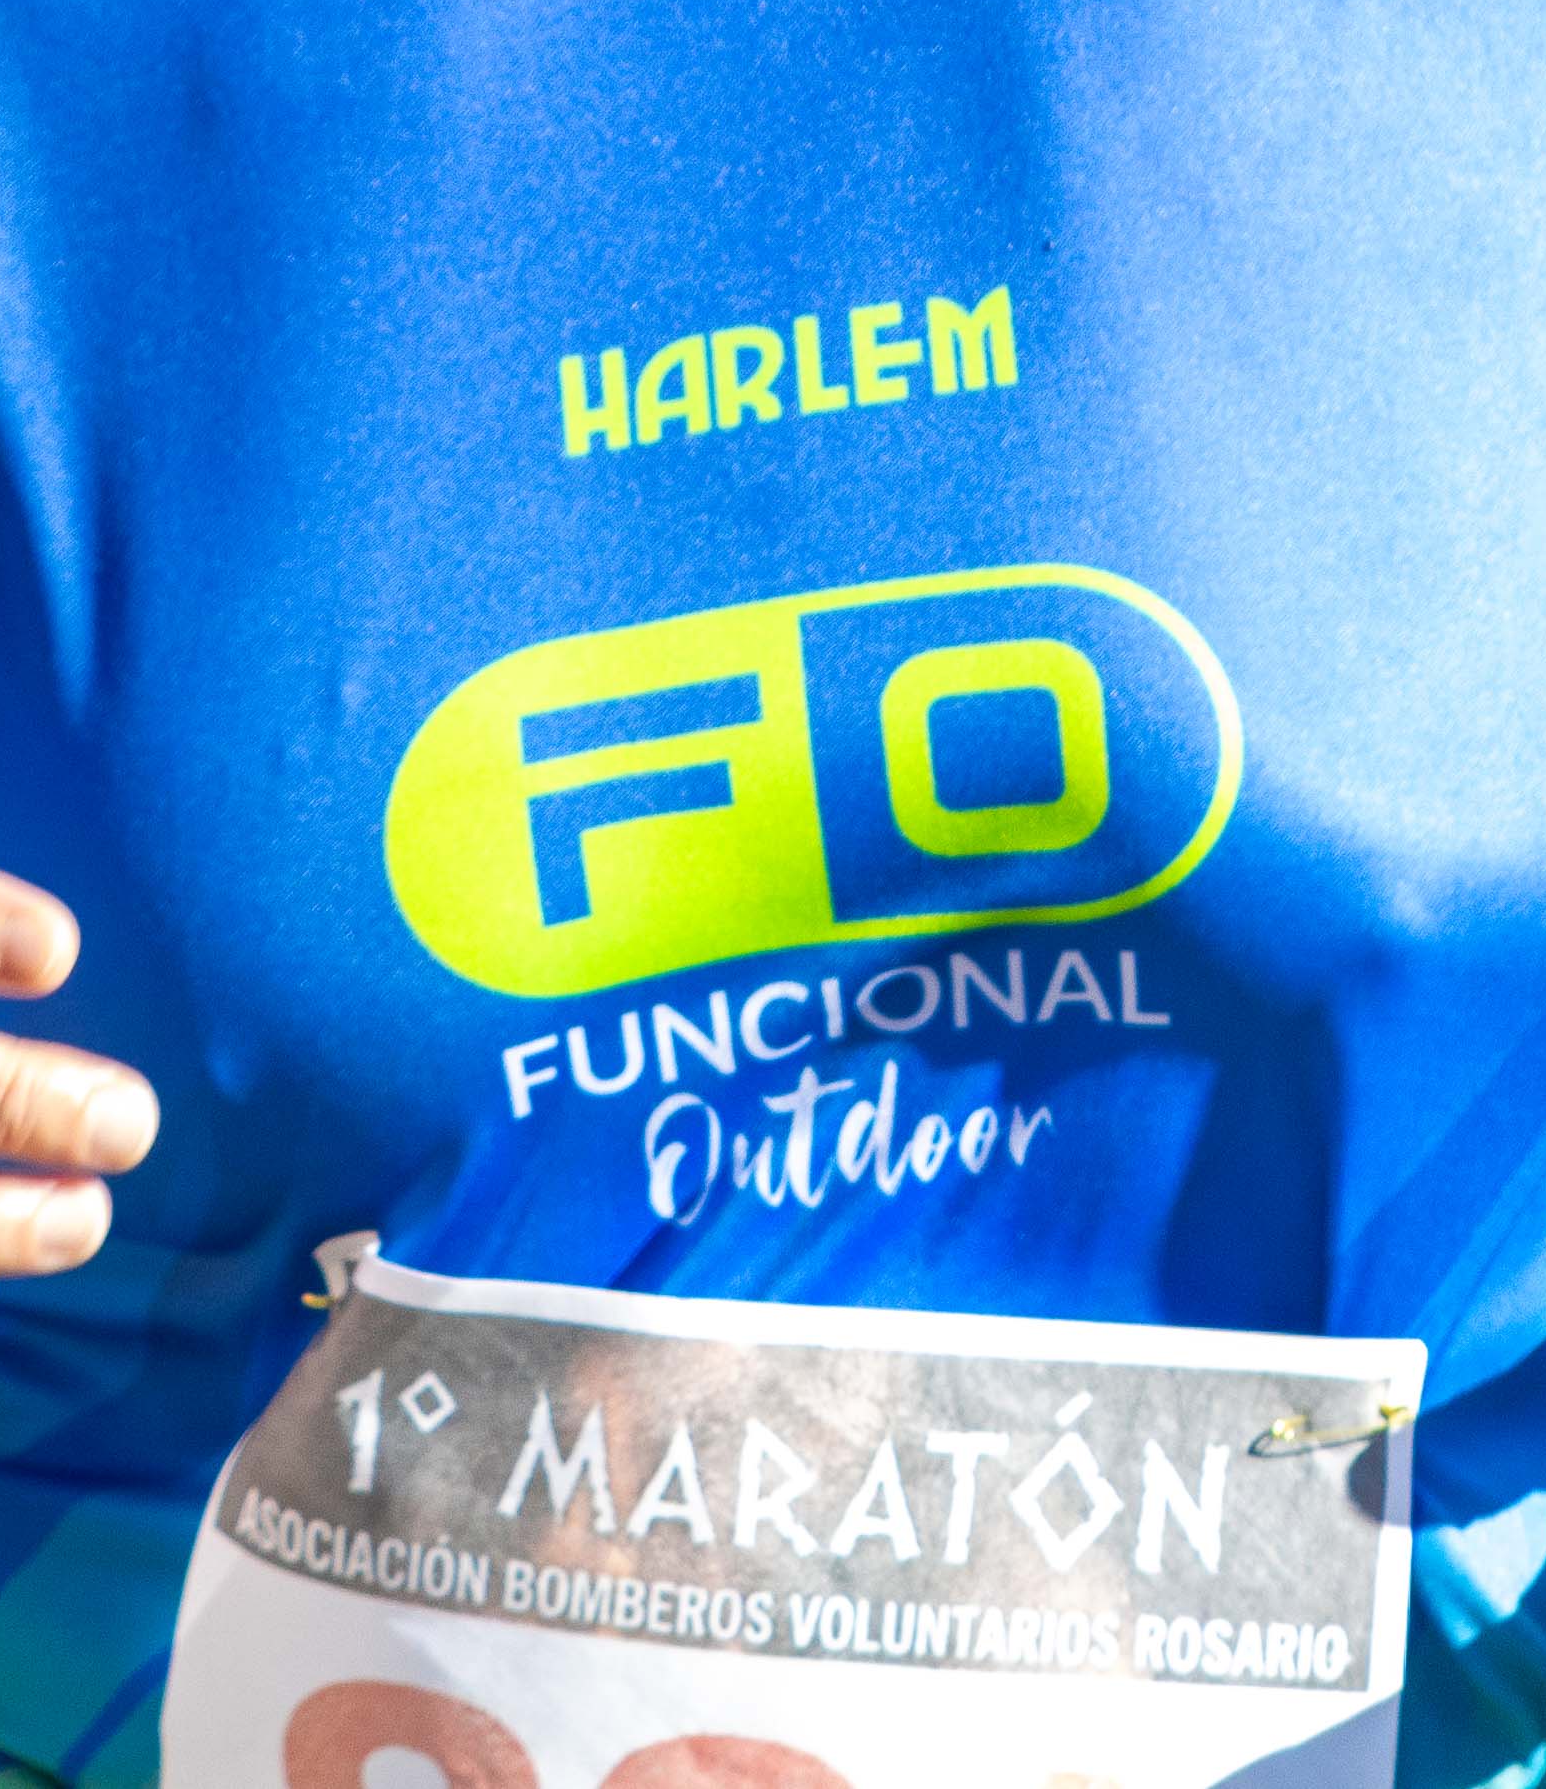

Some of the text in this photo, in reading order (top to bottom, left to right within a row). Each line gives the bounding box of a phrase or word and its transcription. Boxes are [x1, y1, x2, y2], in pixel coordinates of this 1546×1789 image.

[559, 285, 1019, 458] HARLEM
[503, 950, 1170, 1119] FUNCIONAL
[645, 1060, 1052, 1225] Outdoor
[496, 1389, 1230, 1574] MARATÓN
[237, 1487, 1351, 1682] ASOCIACIÓN BOMBEROS VOLUNTARIOS ROSARIO
